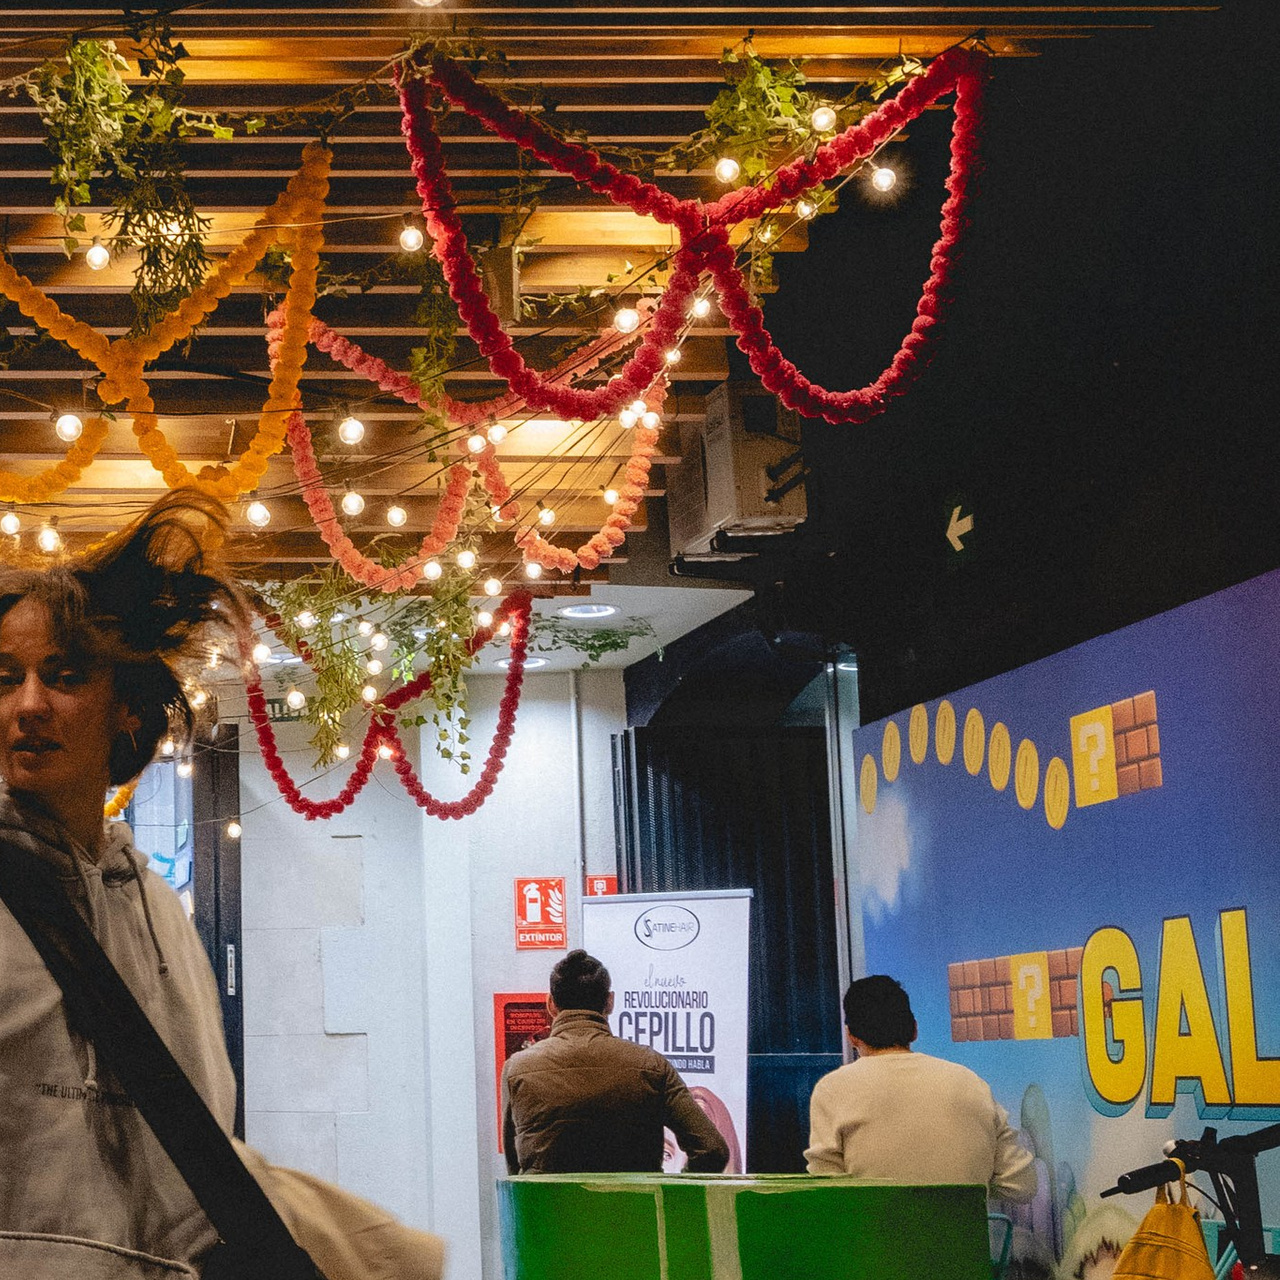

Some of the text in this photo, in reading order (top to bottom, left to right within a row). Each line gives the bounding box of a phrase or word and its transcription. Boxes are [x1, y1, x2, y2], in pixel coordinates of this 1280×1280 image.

[519, 933, 563, 942] EXTINTOR
[624, 990, 708, 1009] REVOLUCIONARIO
[1078, 906, 1280, 1116] GAL
[687, 1058, 711, 1070] HABLA
